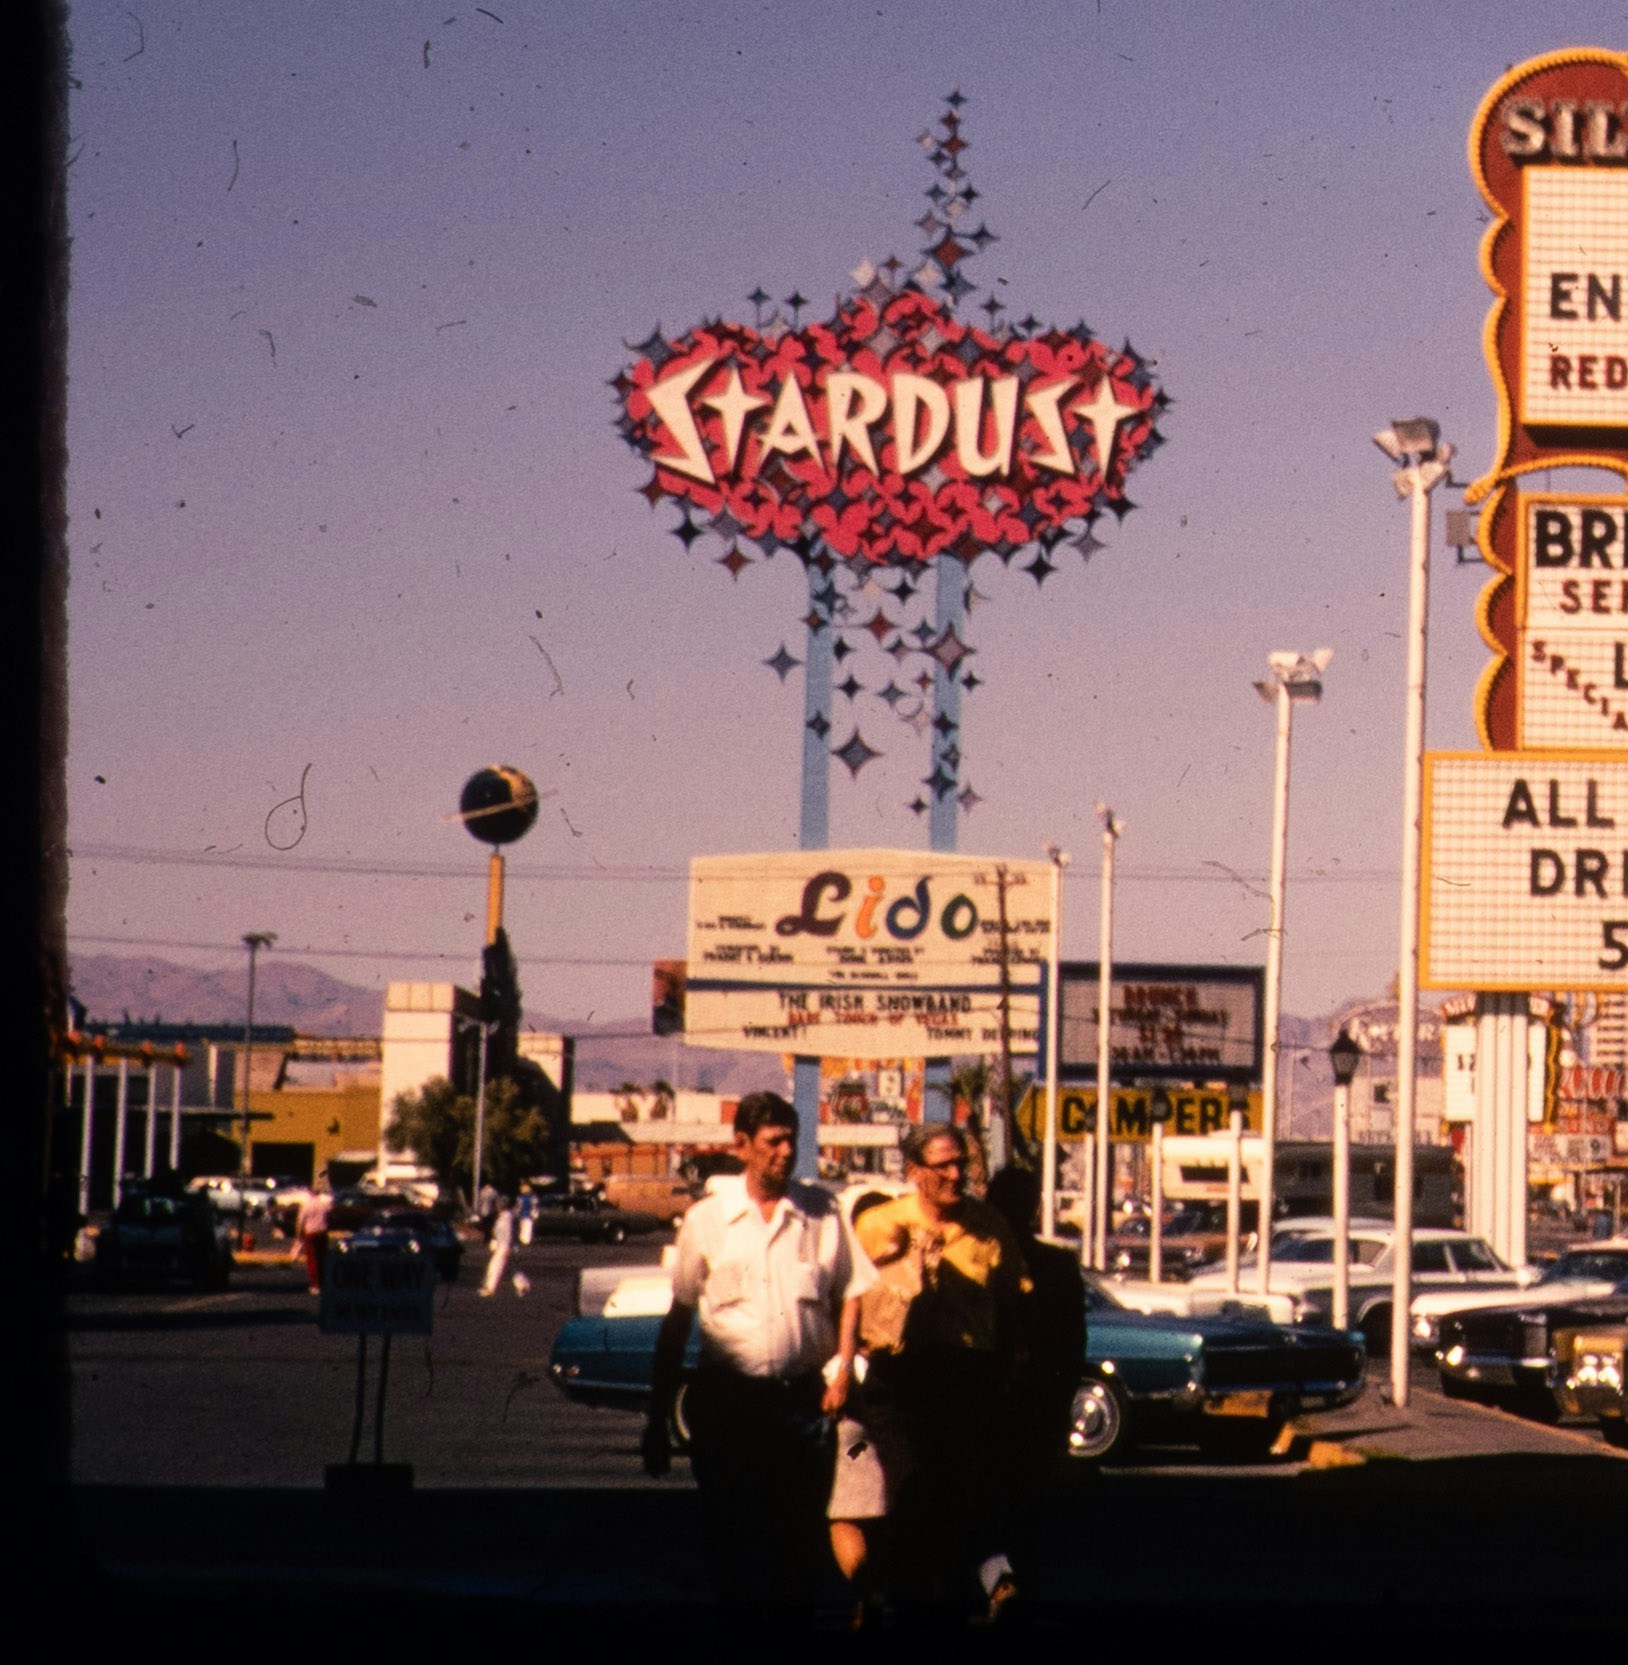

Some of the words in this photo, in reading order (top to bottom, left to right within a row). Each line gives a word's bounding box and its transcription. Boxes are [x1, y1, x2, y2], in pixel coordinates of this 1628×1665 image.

[1549, 355, 1628, 390] RED
[645, 356, 1140, 486] STARDUST
[1502, 778, 1615, 829] ALL
[775, 870, 980, 940] Lido
